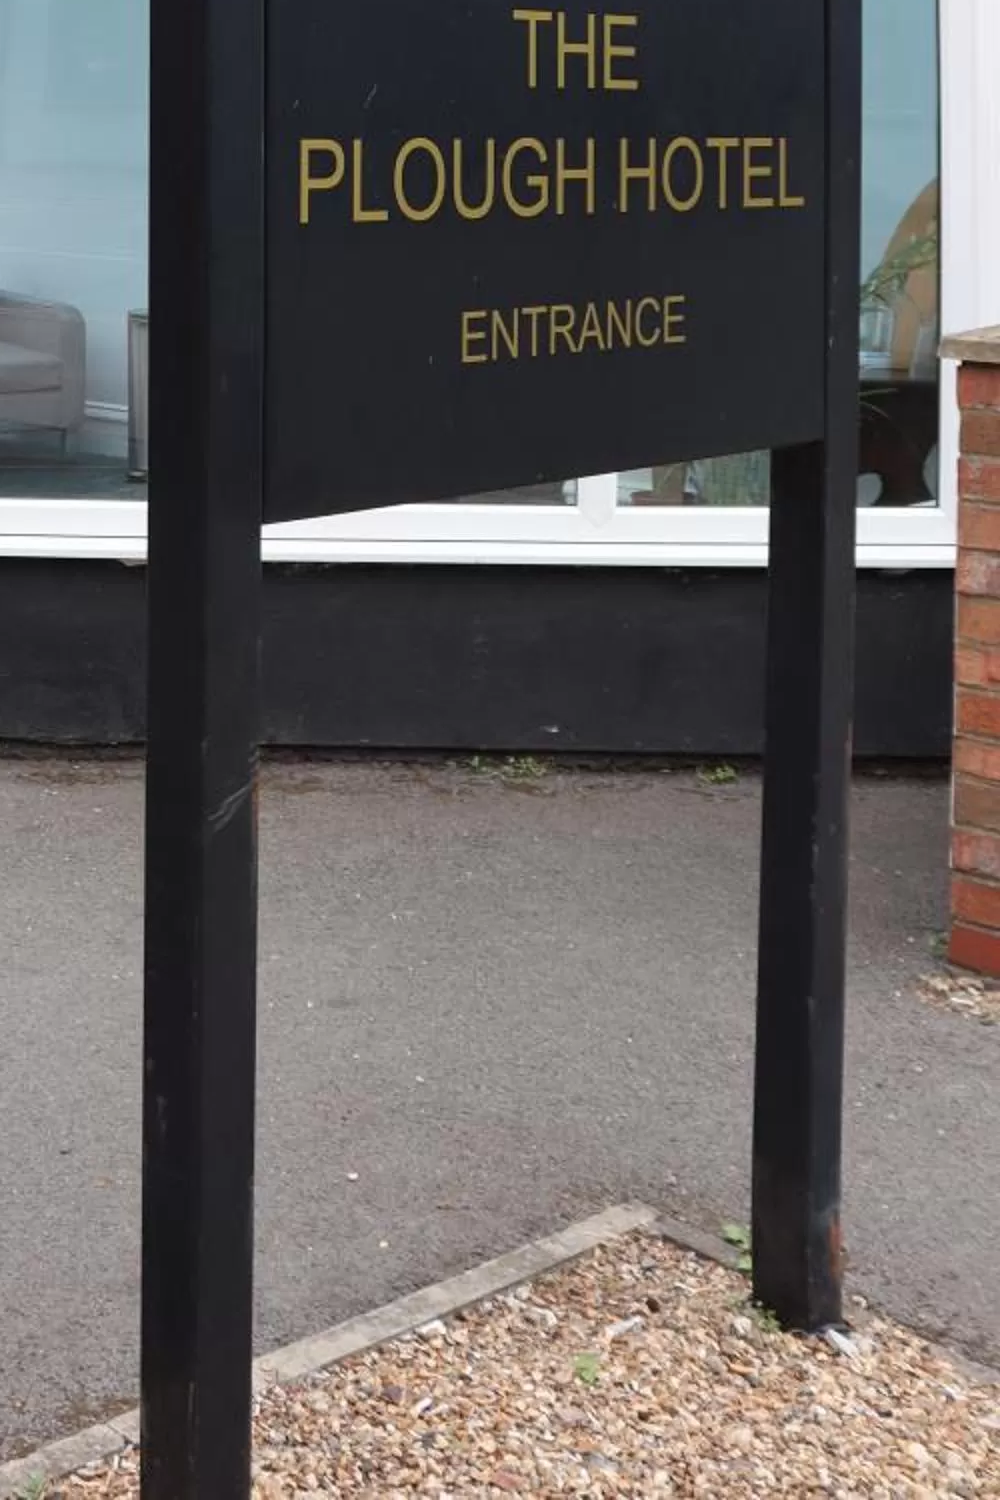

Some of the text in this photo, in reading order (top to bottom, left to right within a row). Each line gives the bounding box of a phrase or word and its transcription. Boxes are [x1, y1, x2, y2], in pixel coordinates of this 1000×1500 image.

[512, 8, 640, 90] THE
[298, 135, 806, 224] PLOUGH HOTEL
[460, 295, 687, 363] ENTRANCE
